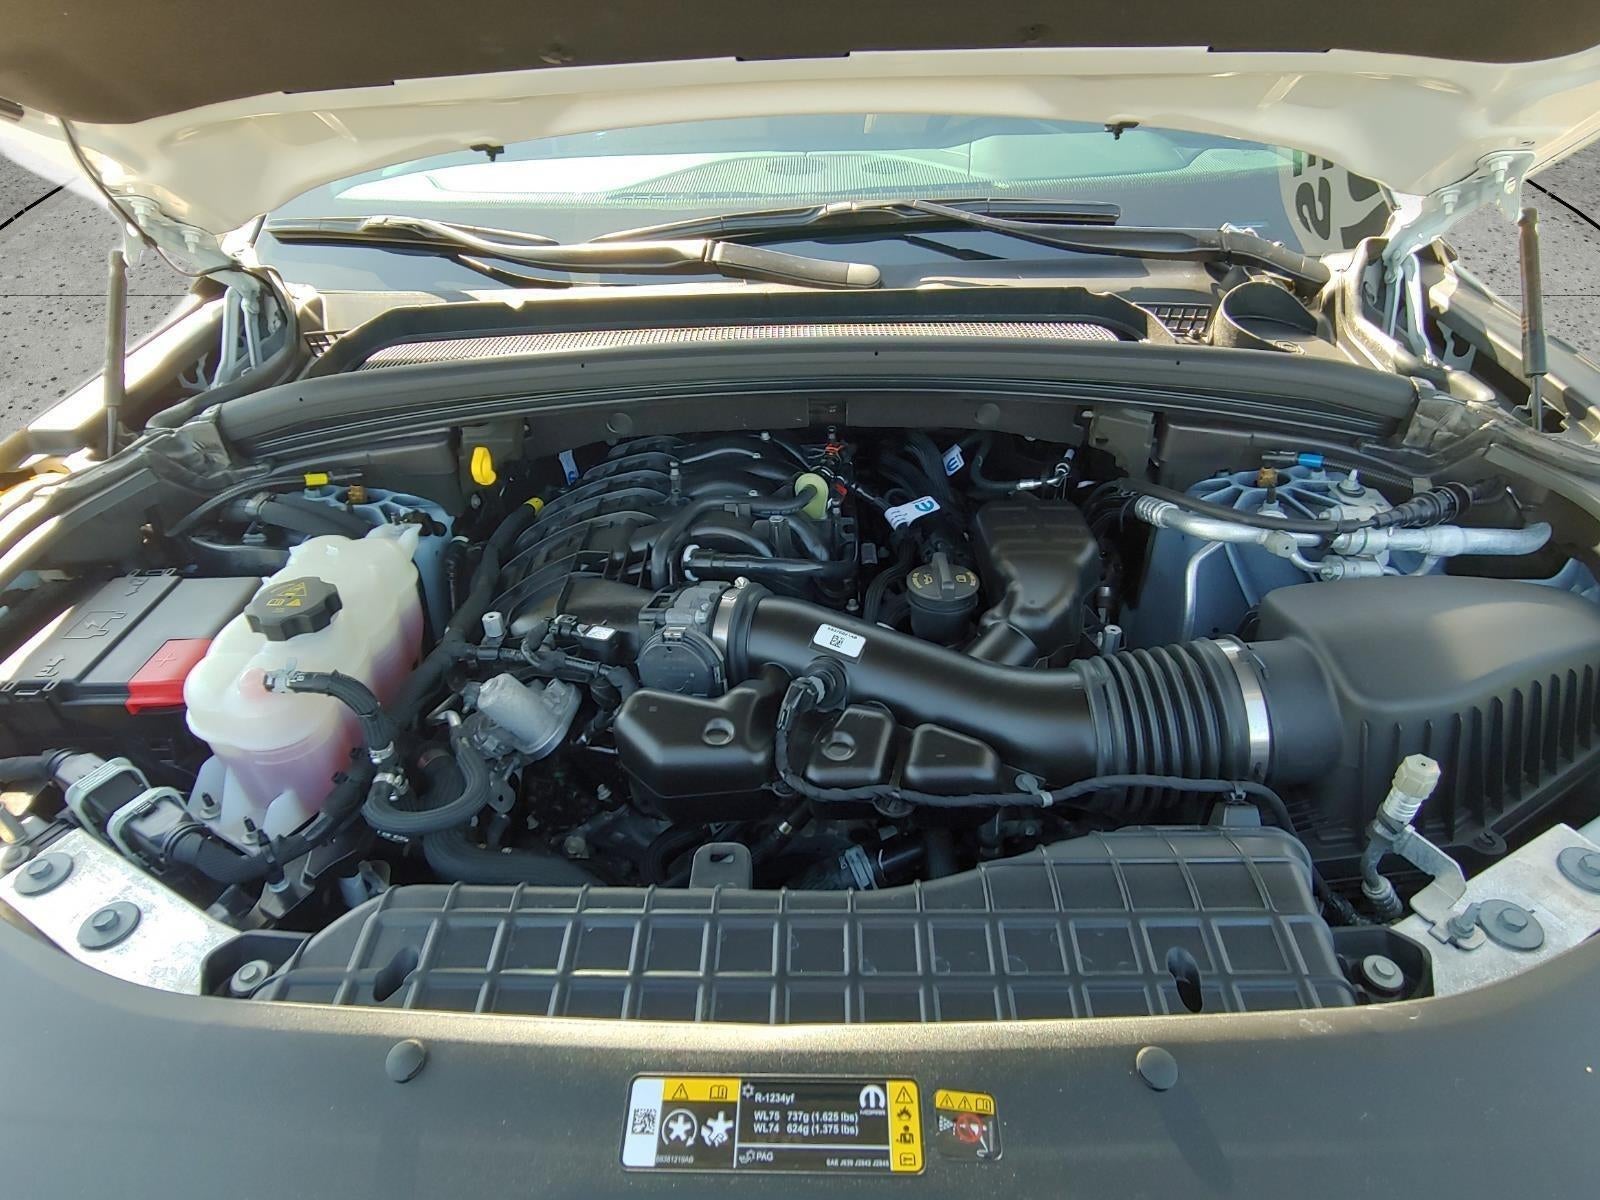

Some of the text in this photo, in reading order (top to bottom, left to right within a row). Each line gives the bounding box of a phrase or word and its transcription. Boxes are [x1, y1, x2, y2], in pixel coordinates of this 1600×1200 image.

[754, 1092, 796, 1106] R-1234yf
[787, 1111, 809, 1123] 737g
[841, 1112, 859, 1124] lbs)
[753, 1123, 779, 1133] WL74
[786, 1124, 809, 1136] 624g
[841, 1124, 859, 1136] lbs)
[756, 1151, 774, 1161] PAG
